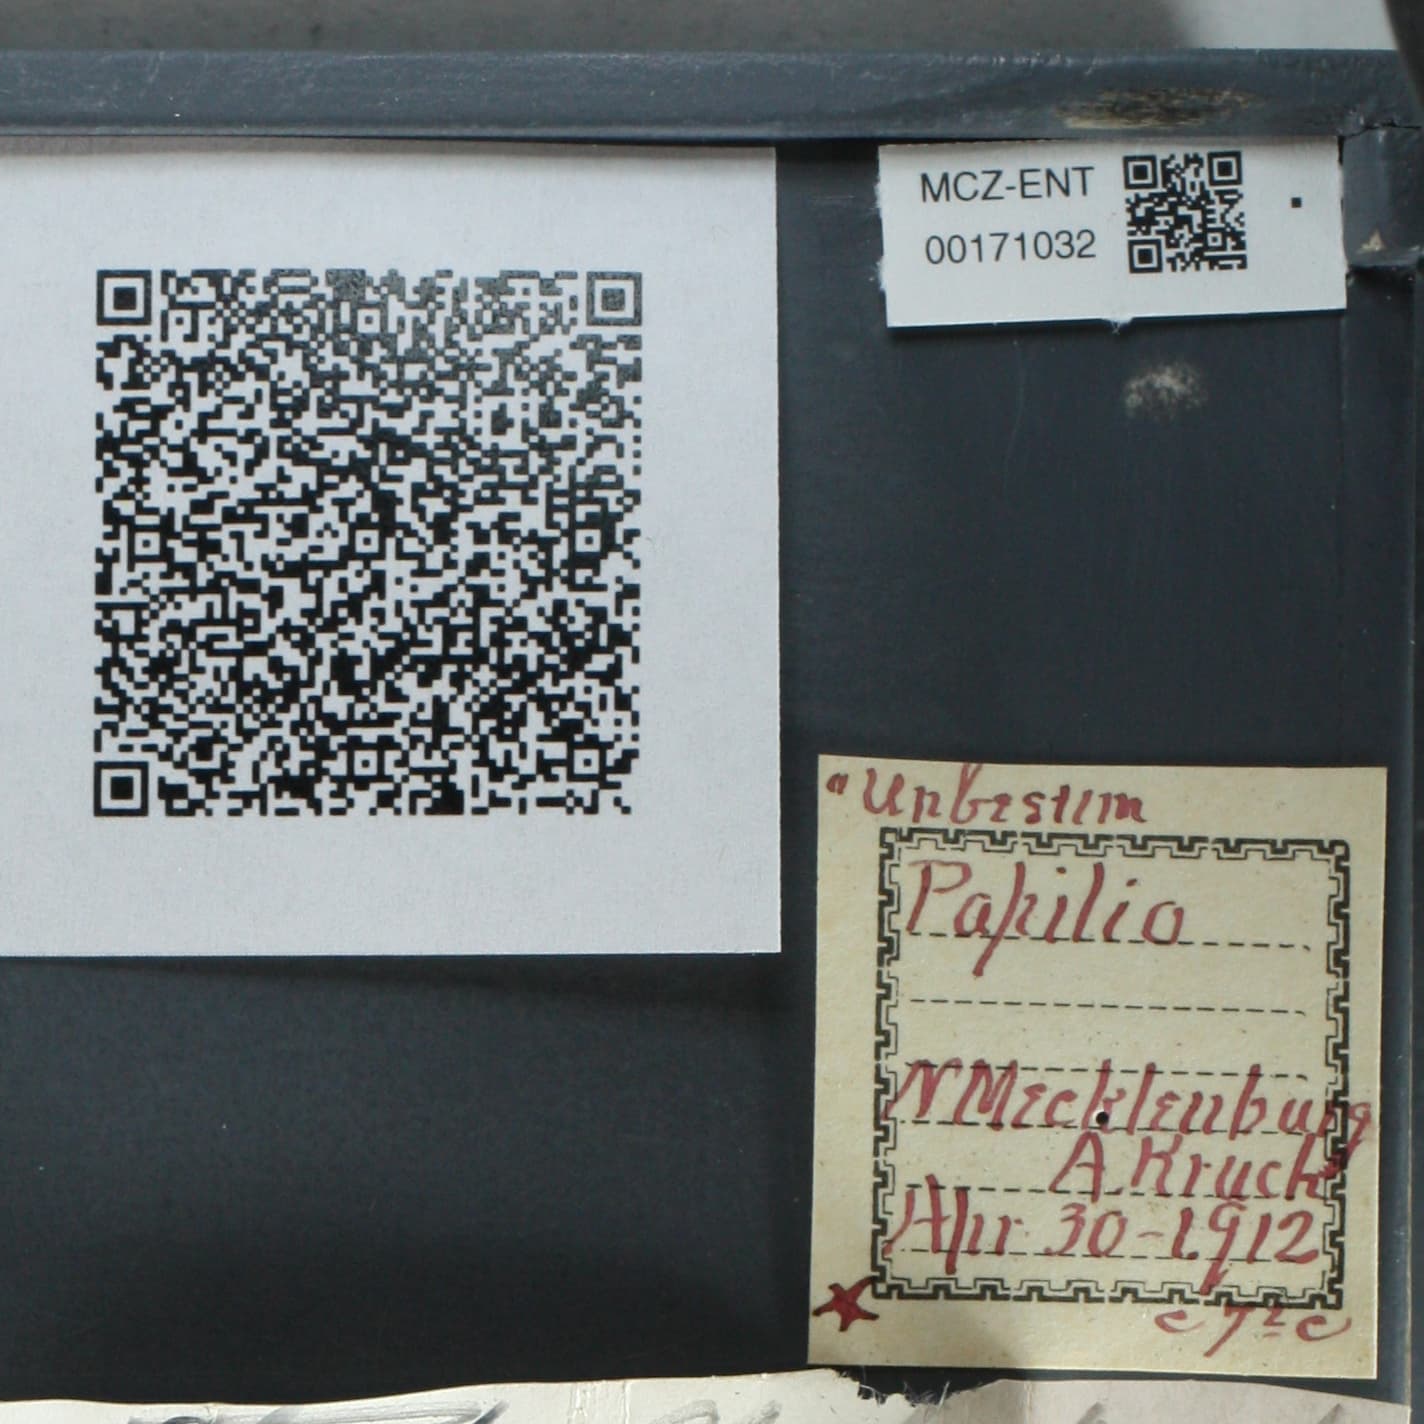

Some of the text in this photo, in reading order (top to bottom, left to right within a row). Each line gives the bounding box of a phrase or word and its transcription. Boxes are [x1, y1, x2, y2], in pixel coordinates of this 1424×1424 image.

[920, 166, 1095, 203] MCZ-ENT
[925, 228, 1097, 265] 00171032
[905, 858, 1184, 977] Papilio
